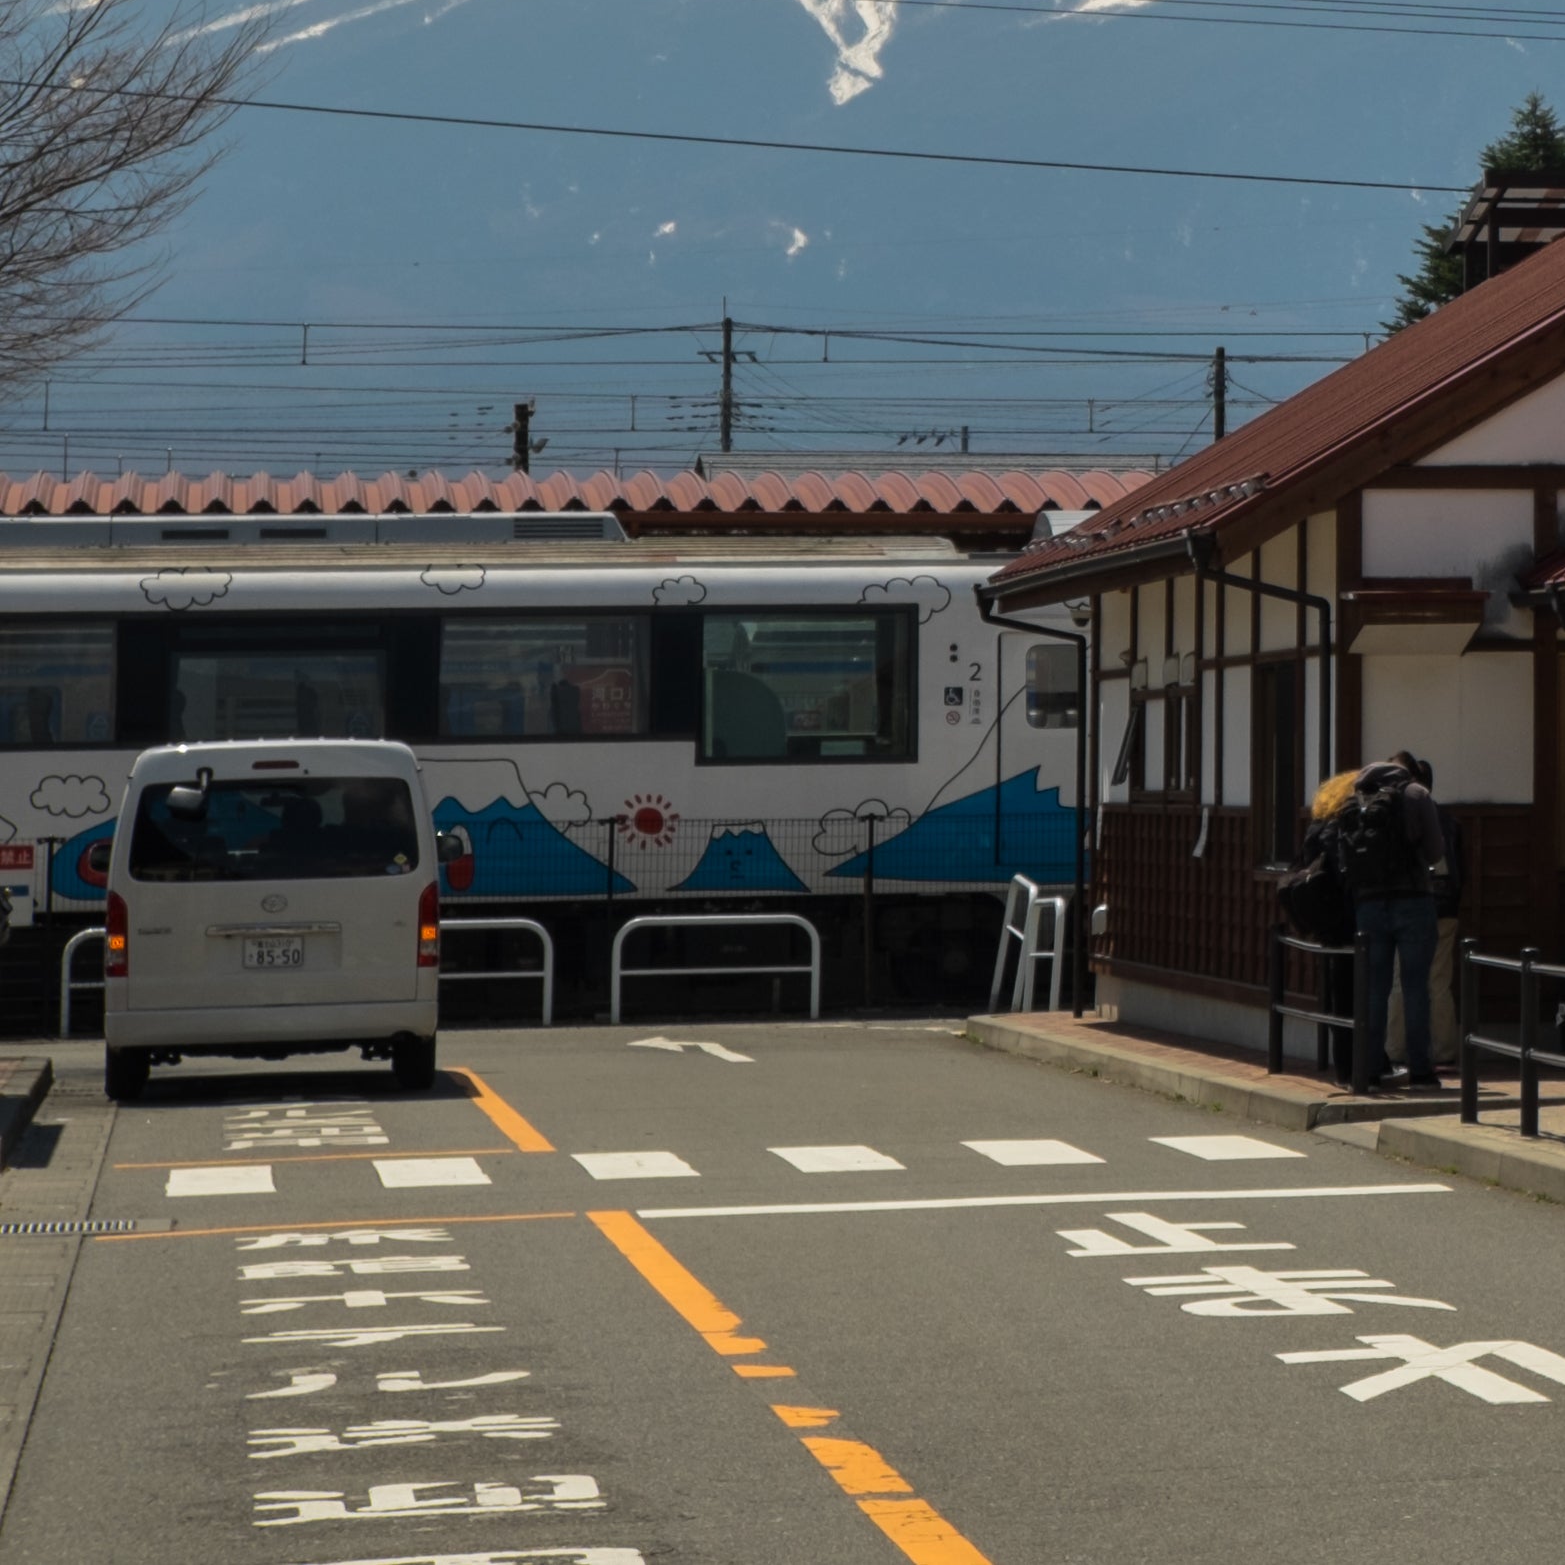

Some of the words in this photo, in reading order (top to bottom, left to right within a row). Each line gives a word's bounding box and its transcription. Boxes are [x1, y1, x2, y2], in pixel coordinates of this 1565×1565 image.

[969, 662, 981, 681] 2
[256, 948, 300, 964] 85-50
[235, 1228, 646, 1565] 旅館ホテル送迎
